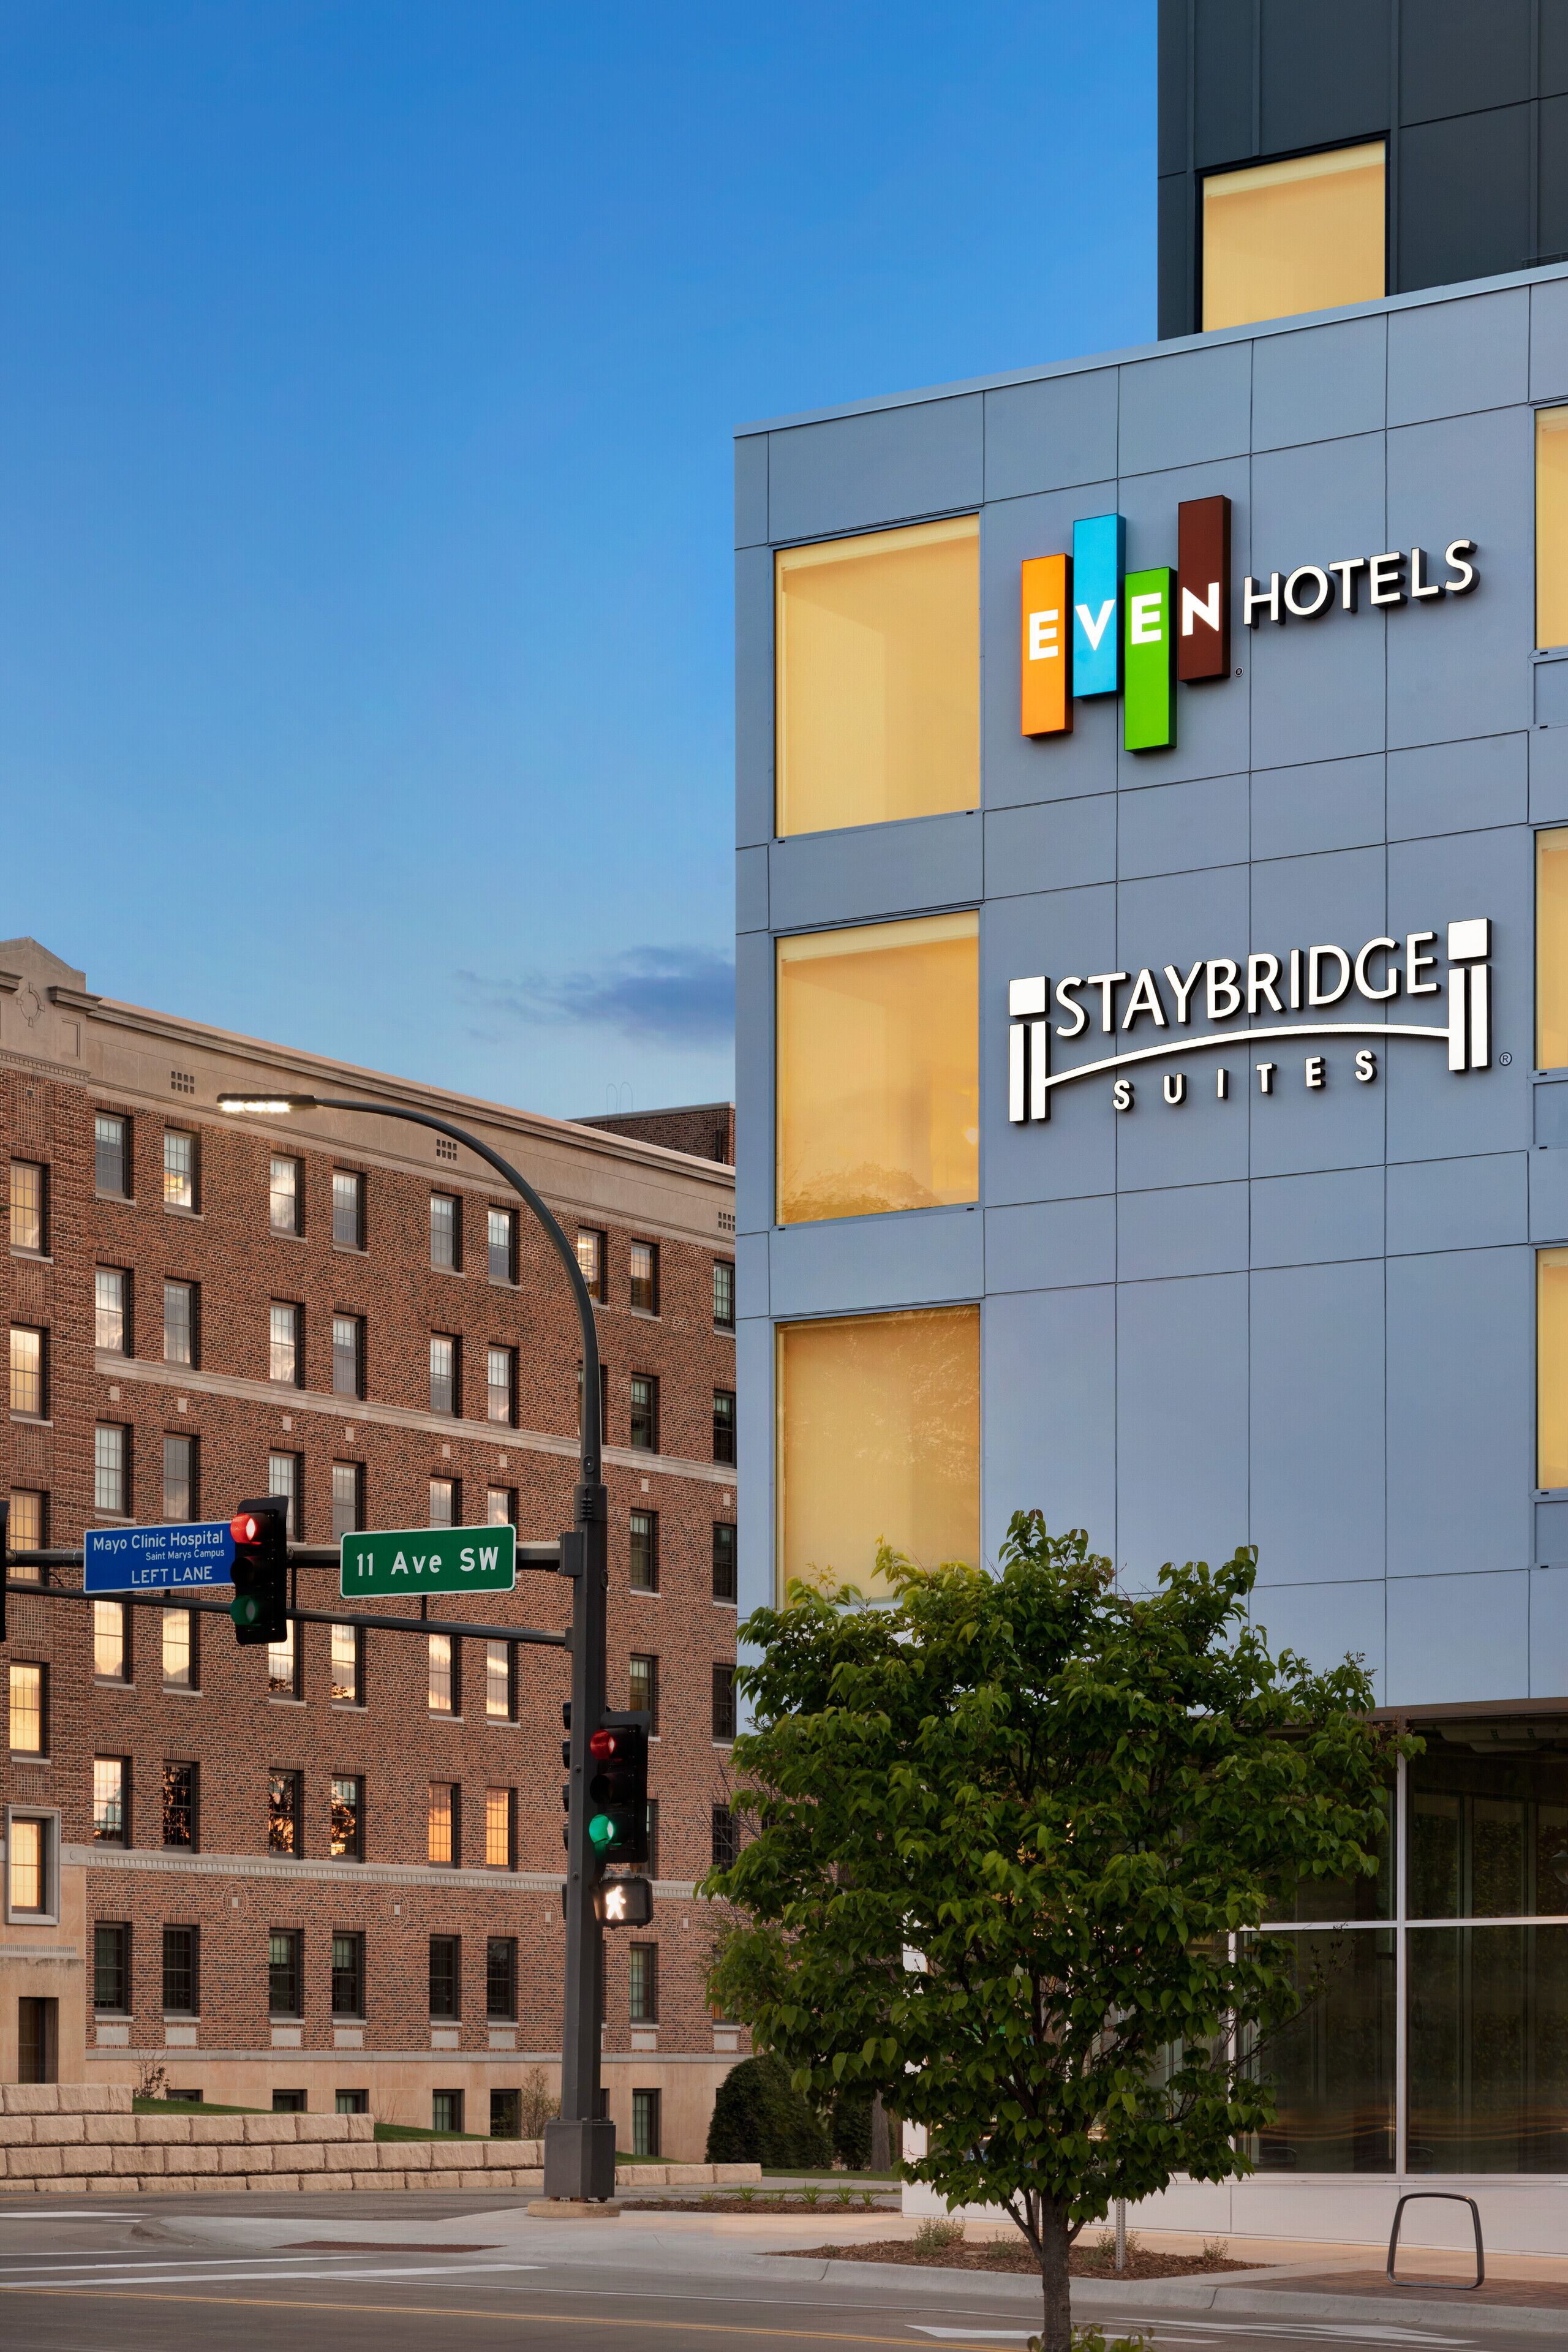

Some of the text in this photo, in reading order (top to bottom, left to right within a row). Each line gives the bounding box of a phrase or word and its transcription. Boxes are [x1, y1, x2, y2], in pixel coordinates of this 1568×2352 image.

[1029, 539, 1477, 660] EVEN HOTELS
[1055, 930, 1439, 1038] STAYBRIDGE
[1112, 1050, 1376, 1111] SUITES
[94, 1530, 223, 1554] Mayo Clinic Hospital
[146, 1549, 225, 1561] Saint Marys Campus
[132, 1566, 213, 1584] LEFT LANE
[356, 1547, 499, 1577] 11 Ave SW
